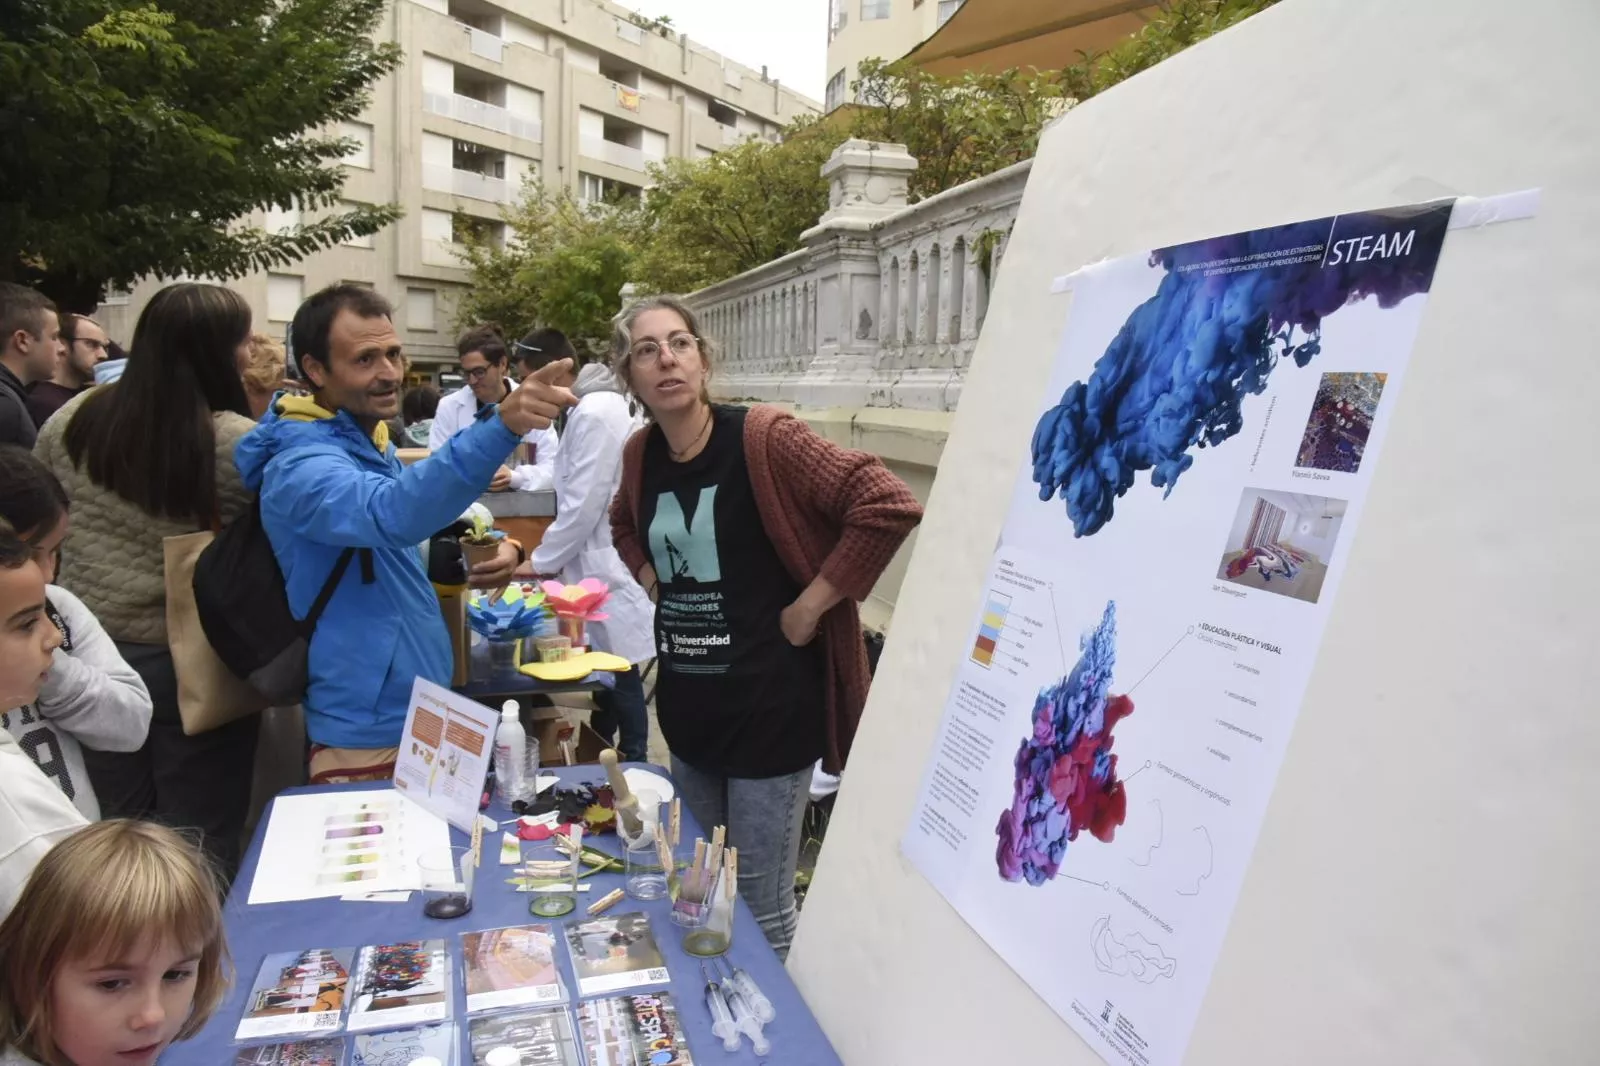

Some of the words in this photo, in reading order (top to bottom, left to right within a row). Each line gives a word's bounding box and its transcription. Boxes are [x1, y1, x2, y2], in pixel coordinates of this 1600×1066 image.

[1329, 230, 1416, 266] STEAM
[1304, 254, 1321, 262] STEAM
[671, 634, 731, 645] Universidad
[1202, 623, 1231, 638] EDUCACIÓN
[1231, 631, 1256, 645] PLÁSTICA
[1261, 641, 1282, 655] VISUAL
[674, 645, 708, 656] Zaragoza
